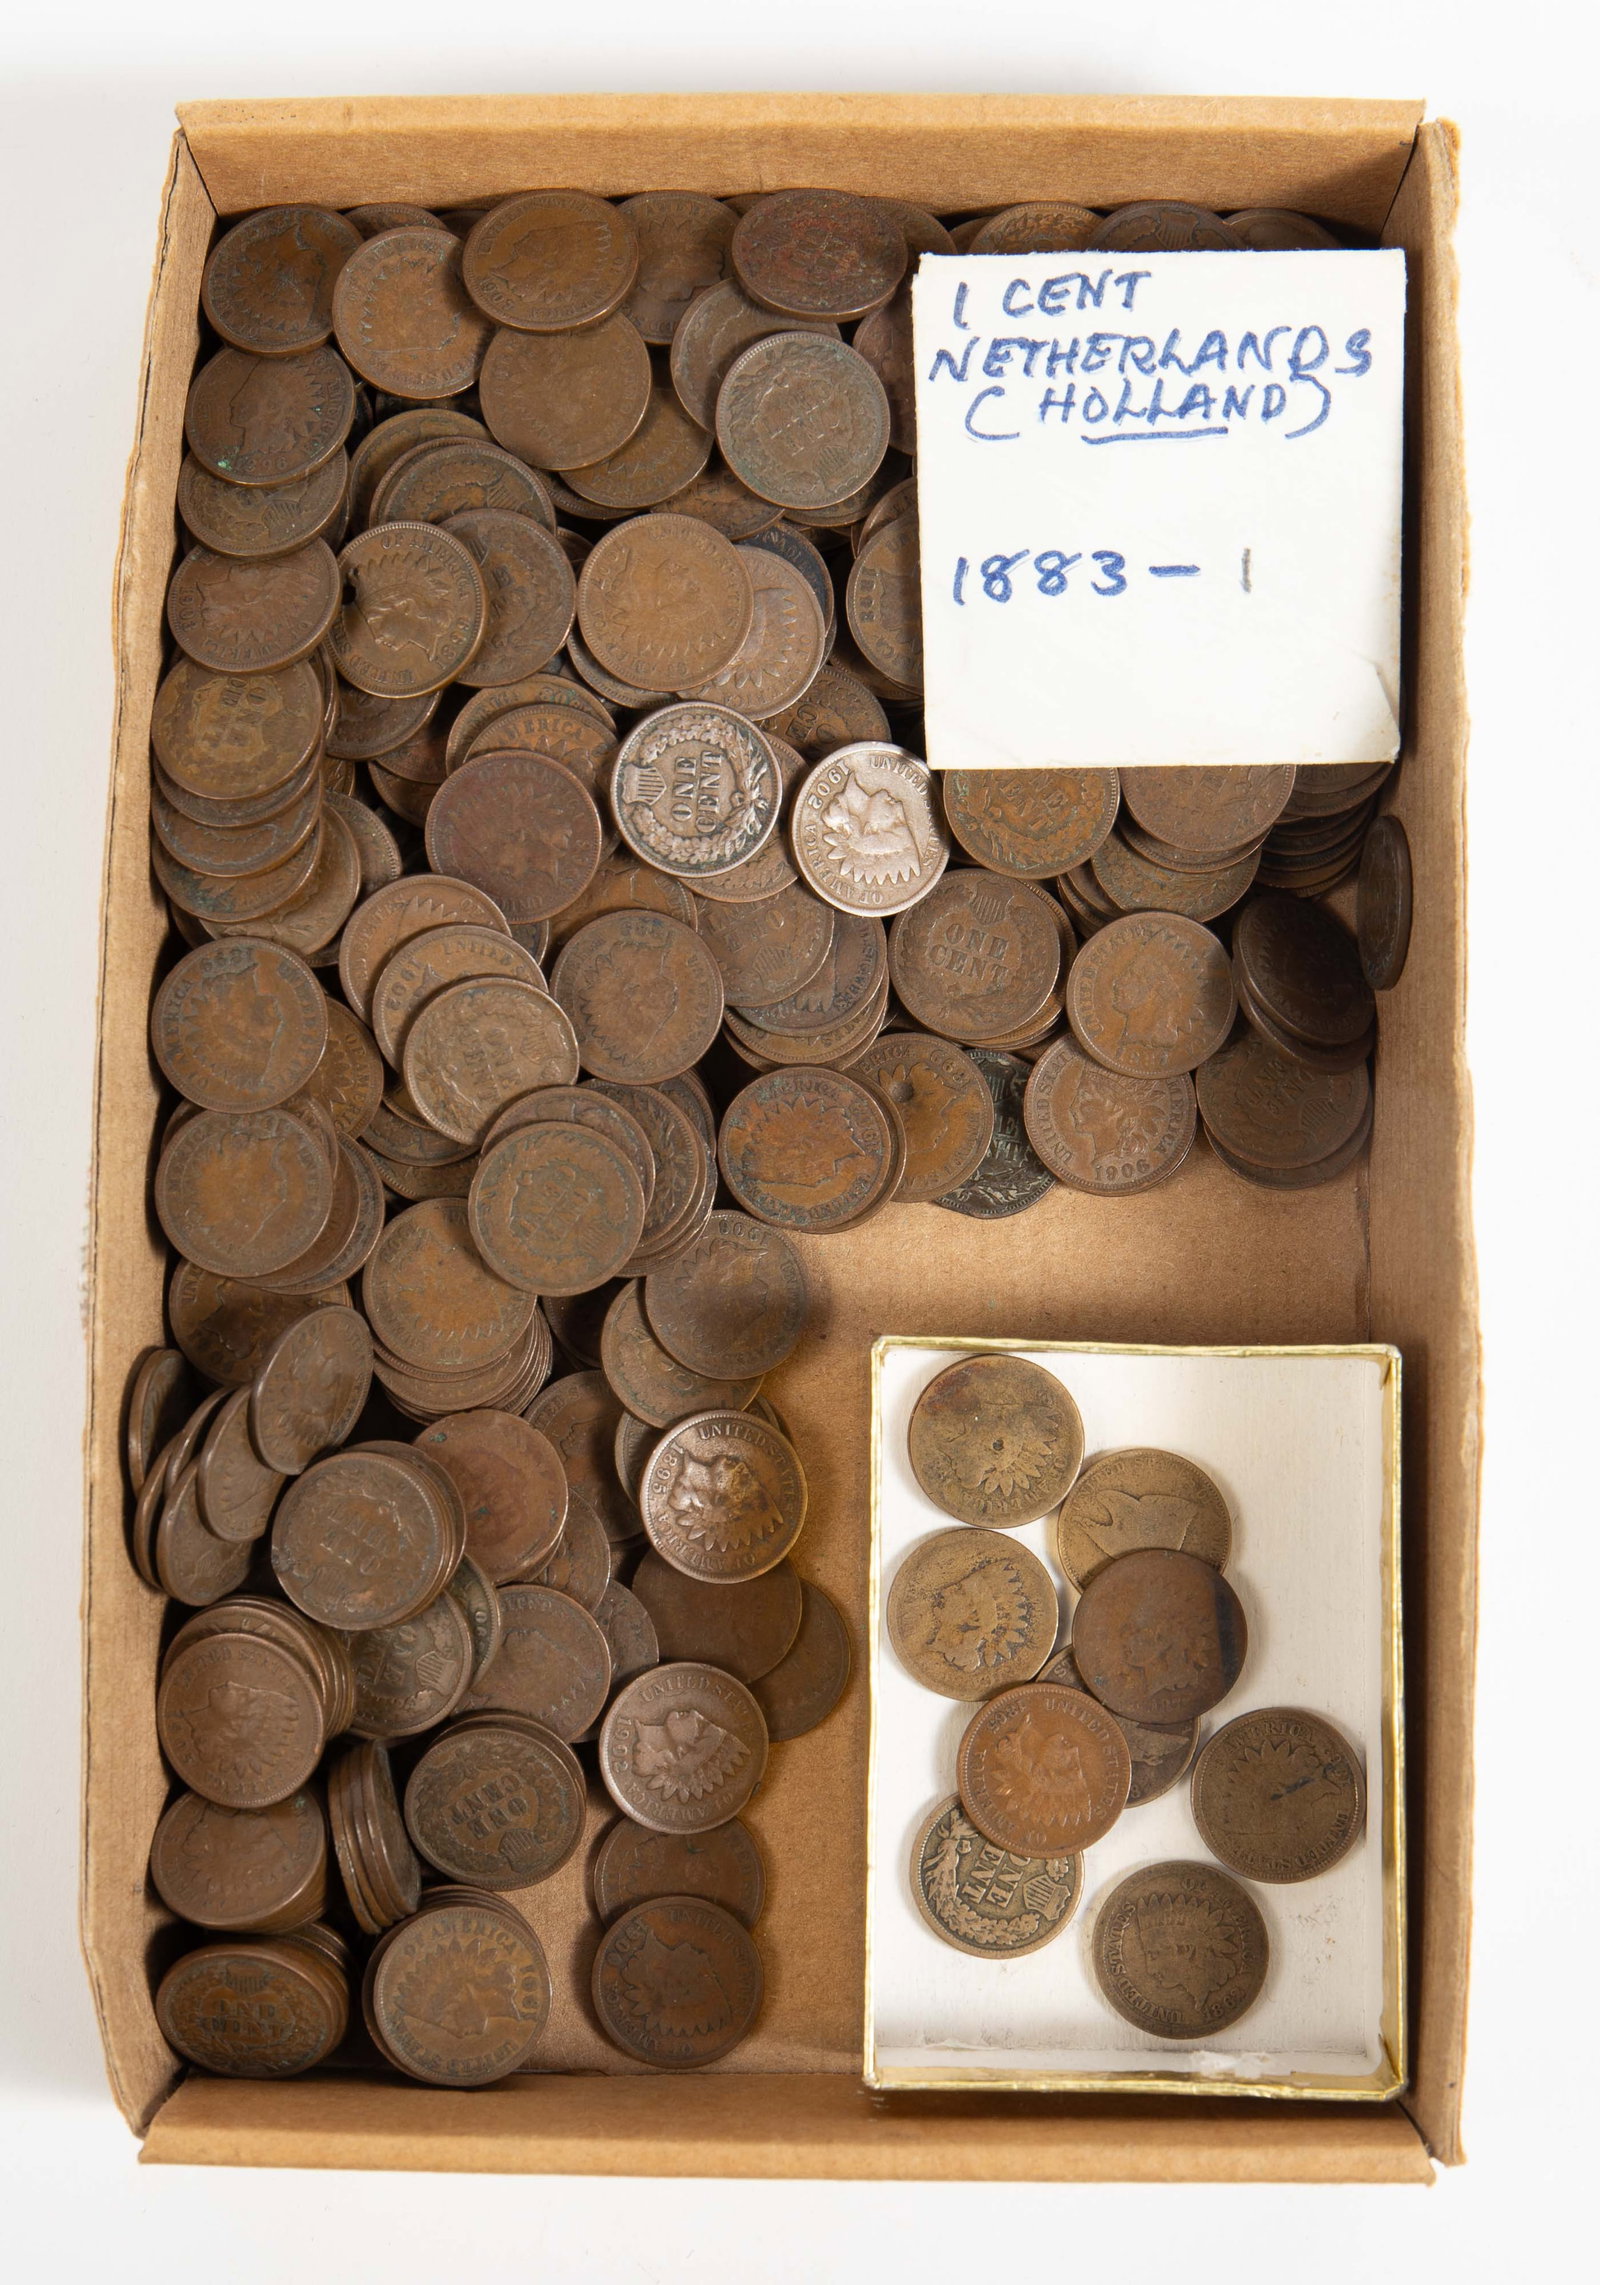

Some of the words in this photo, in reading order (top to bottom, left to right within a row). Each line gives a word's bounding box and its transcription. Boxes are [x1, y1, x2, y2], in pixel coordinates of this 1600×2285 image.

[952, 281, 969, 330] 1
[1002, 268, 1152, 319] CENT
[928, 325, 1373, 382] NETHERLANDS
[952, 549, 1128, 606] 1883
[673, 756, 698, 822] ONE
[696, 750, 723, 834] CENT
[811, 761, 851, 810] 1902
[870, 756, 929, 797] UNITED
[802, 824, 854, 902] AMERICA
[928, 942, 1009, 981] CENT
[945, 923, 1009, 960] ONE
[1037, 1098, 1075, 1165] UNITED
[1094, 1158, 1151, 1182] 1906
[699, 1422, 769, 1449] UNITED
[652, 1442, 688, 1495] 1895
[640, 1675, 714, 1704] UNITED
[612, 1717, 634, 1774] 1902
[1117, 1972, 1185, 2026] UNITED
